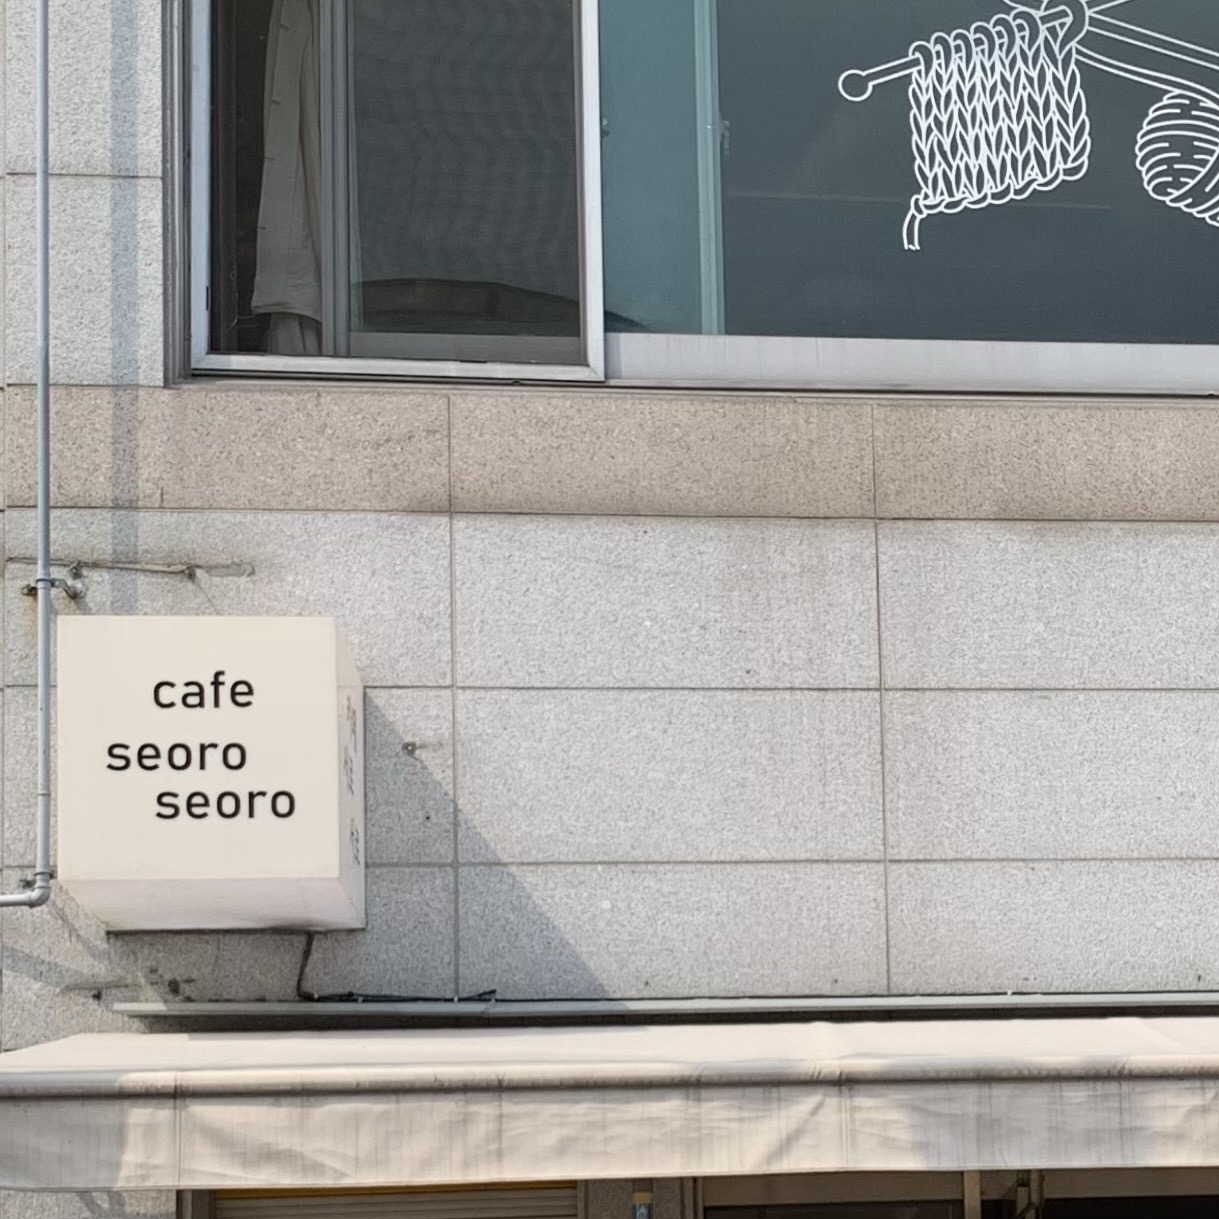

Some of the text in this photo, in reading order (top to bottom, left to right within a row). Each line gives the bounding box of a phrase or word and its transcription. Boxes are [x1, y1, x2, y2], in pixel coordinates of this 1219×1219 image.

[153, 670, 254, 708] cafe
[106, 742, 247, 771] seoro
[155, 790, 295, 820] seoro
